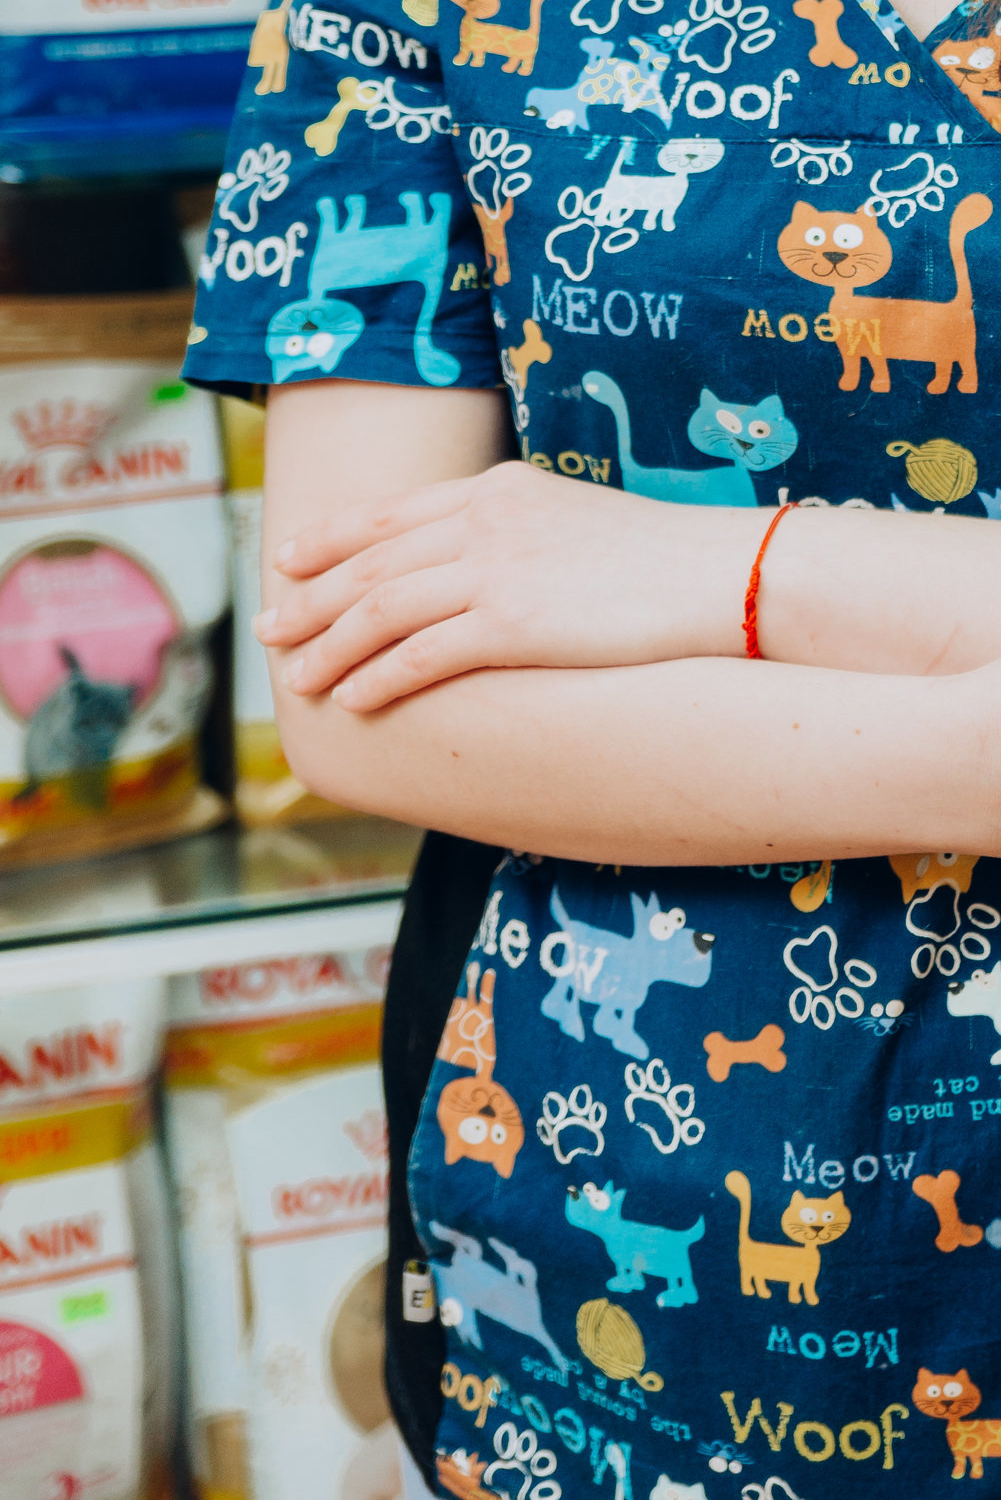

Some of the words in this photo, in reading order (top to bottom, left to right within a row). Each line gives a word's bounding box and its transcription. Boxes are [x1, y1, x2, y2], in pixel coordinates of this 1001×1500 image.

[617, 65, 800, 130] Woof
[531, 275, 683, 341] MEOW
[741, 309, 882, 356] Meow
[521, 436, 613, 484] eow
[933, 1075, 980, 1098] cat
[887, 1102, 955, 1125] made
[782, 1141, 917, 1189] Meow
[766, 1324, 900, 1370] Meow
[650, 1415, 693, 1442] the
[720, 1391, 909, 1470] Woof
